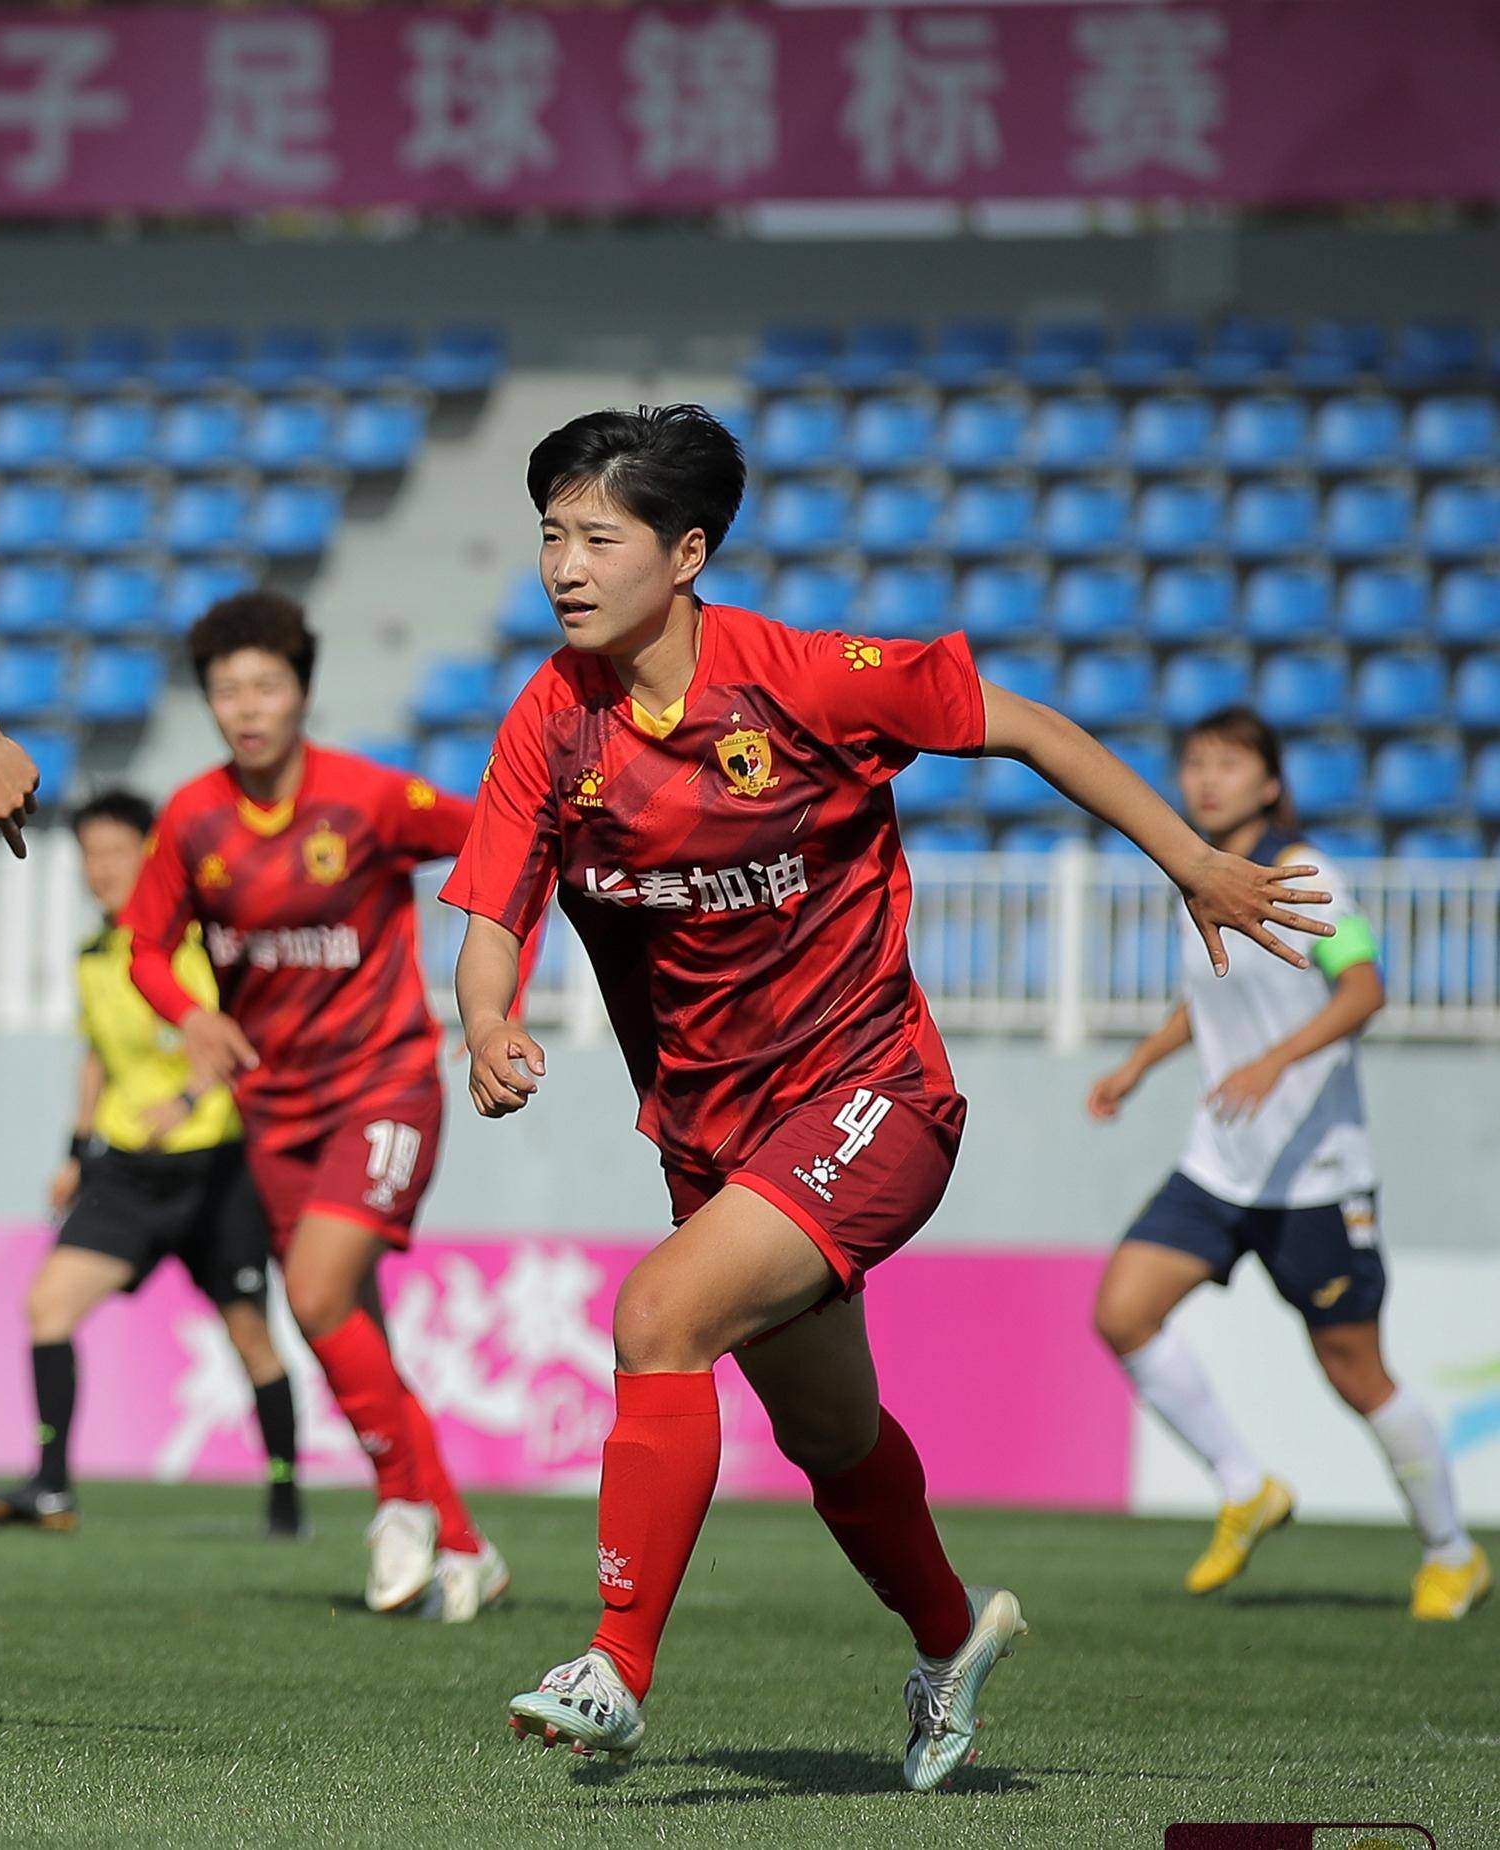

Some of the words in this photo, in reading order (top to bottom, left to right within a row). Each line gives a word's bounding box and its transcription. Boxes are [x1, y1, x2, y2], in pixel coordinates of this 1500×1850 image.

[567, 795, 604, 808] KELME
[583, 852, 809, 913] 长春加油
[832, 1087, 894, 1166] 4
[792, 1165, 835, 1203] KELME
